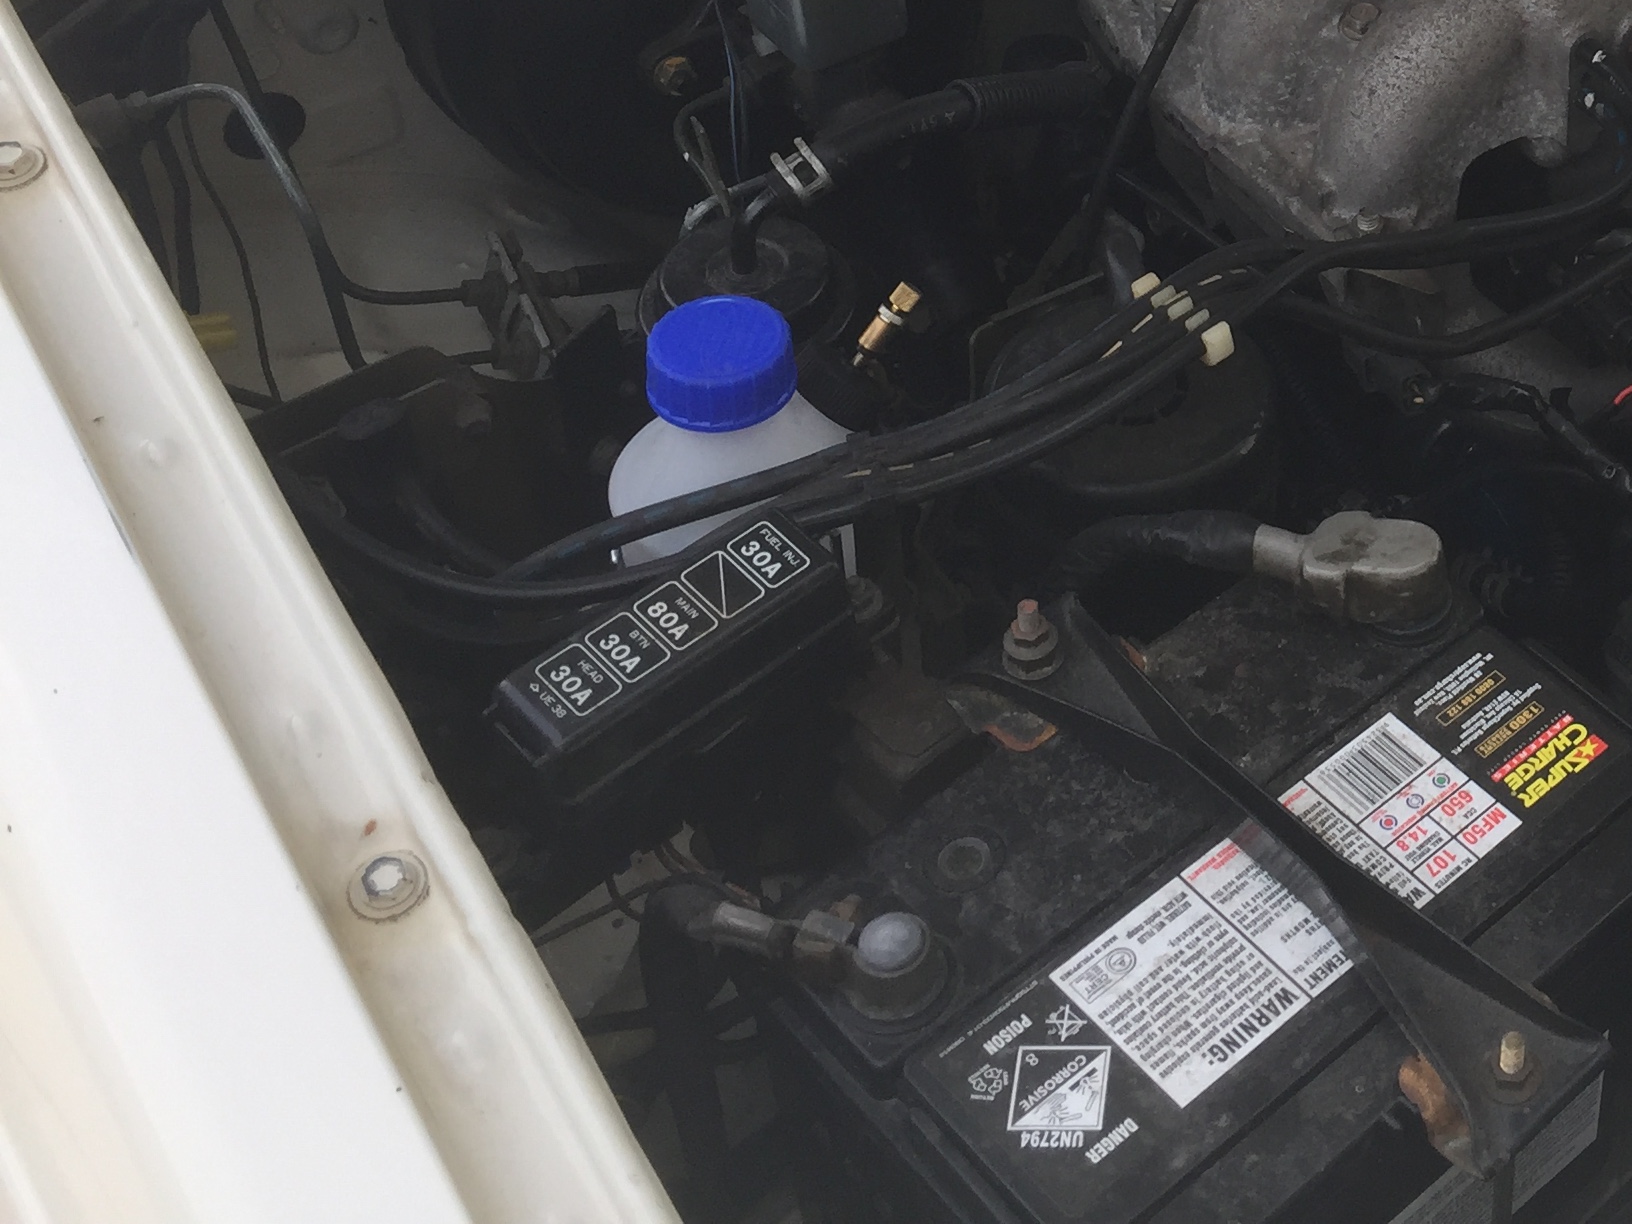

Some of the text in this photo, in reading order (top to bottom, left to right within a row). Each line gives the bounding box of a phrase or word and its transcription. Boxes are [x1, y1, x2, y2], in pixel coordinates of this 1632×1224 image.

[739, 539, 781, 580] 30A
[759, 527, 800, 568] FUEL INJ.
[647, 601, 690, 641] 80A
[675, 597, 700, 618] MAIN
[598, 632, 642, 675] 30A
[629, 629, 651, 649] BTN
[550, 664, 592, 707] 30A
[577, 660, 603, 683] HEAD
[539, 691, 566, 719] UE 38
[1445, 703, 1463, 717] 122
[1507, 704, 1541, 730] 1300
[1490, 714, 1574, 781] BATTERIES
[1500, 720, 1591, 794] CHARGE
[1514, 747, 1592, 811] SUPER
[1438, 788, 1474, 818] 650
[1462, 806, 1477, 819] CCA
[1393, 823, 1429, 852] 14.8
[1460, 805, 1507, 846] MF50
[1421, 847, 1459, 878] 107
[1433, 856, 1472, 889] RC MINUTES
[1082, 971, 1110, 994] CERT
[983, 1014, 1033, 1056] POISON
[1199, 983, 1300, 1070] WARNING:
[1026, 1053, 1039, 1067] 8
[1017, 1054, 1088, 1112] CORROSIVE
[1021, 1130, 1084, 1149] UN2794
[1086, 1117, 1140, 1165] DANGER
